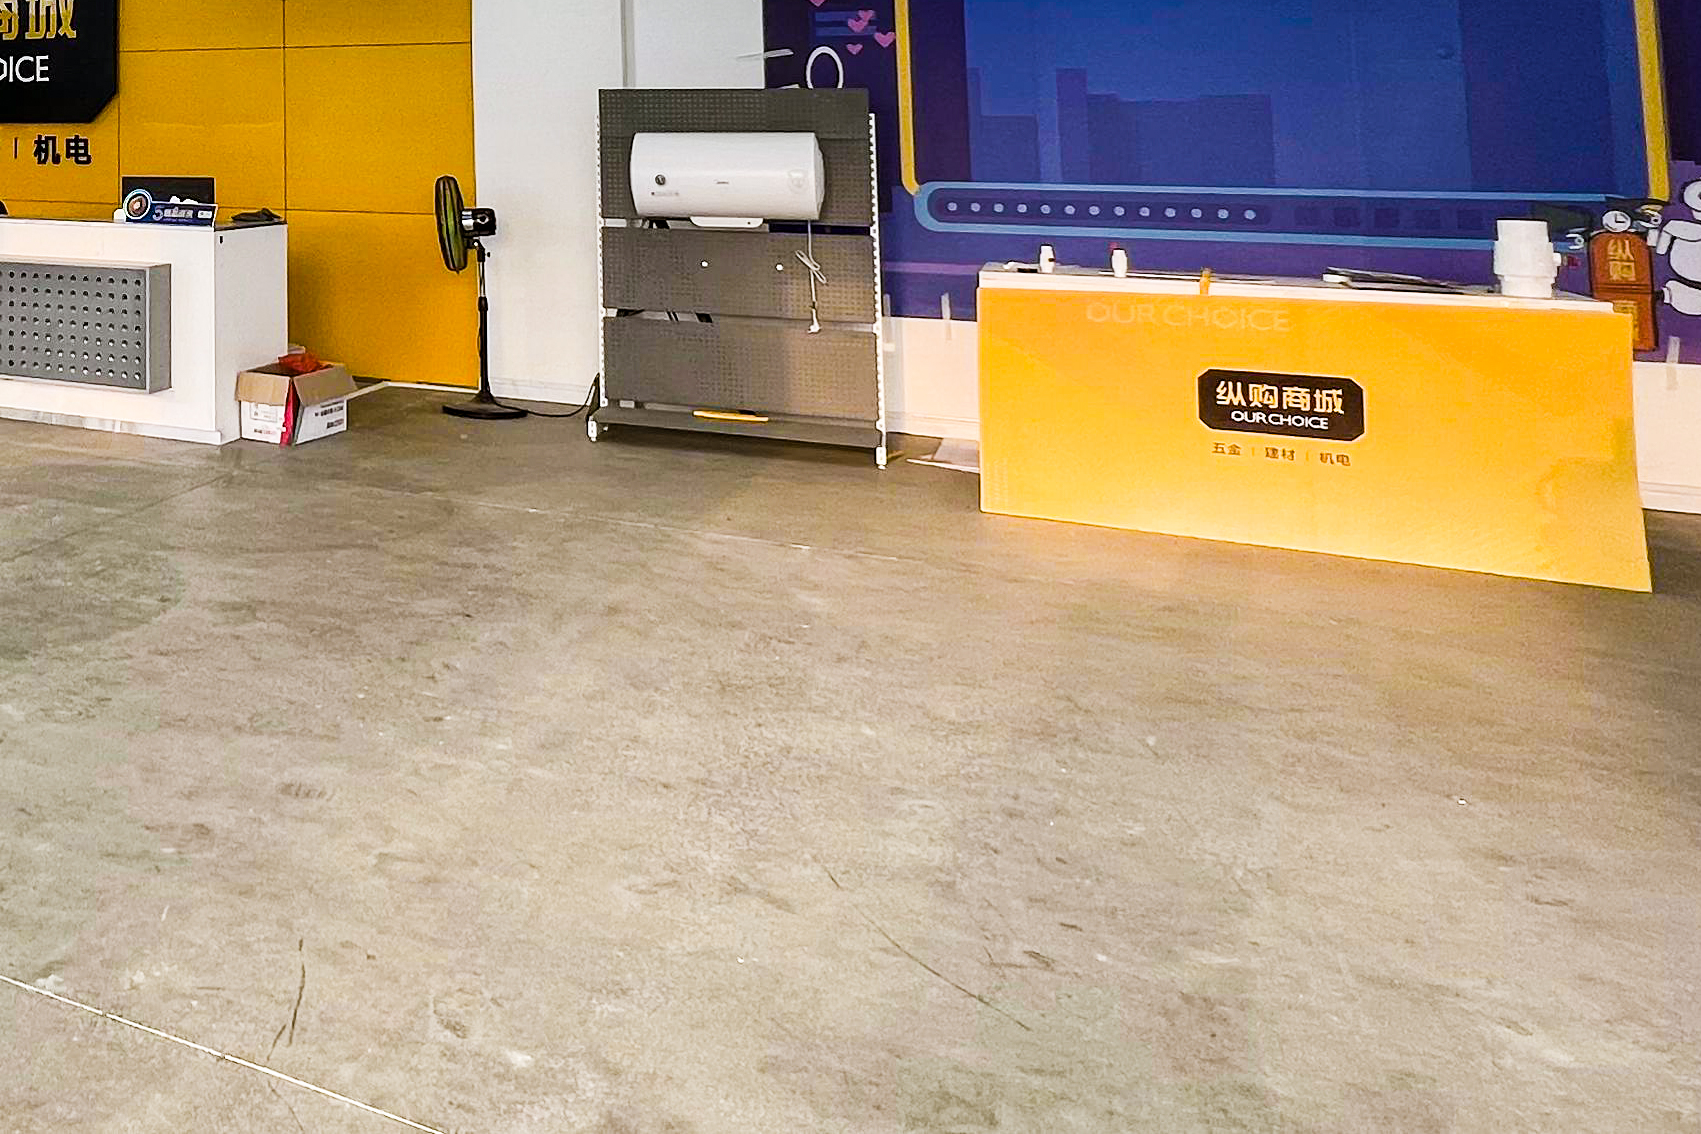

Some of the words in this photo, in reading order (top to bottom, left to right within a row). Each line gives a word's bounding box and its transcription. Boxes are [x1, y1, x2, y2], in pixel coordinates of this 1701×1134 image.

[33, 134, 93, 165] 机电
[1216, 380, 1345, 415] 纵购商城
[1231, 410, 1329, 430] OURCHOICE
[1212, 442, 1242, 456] 五金
[1265, 446, 1296, 461] 建材
[1319, 452, 1352, 467] 机电
